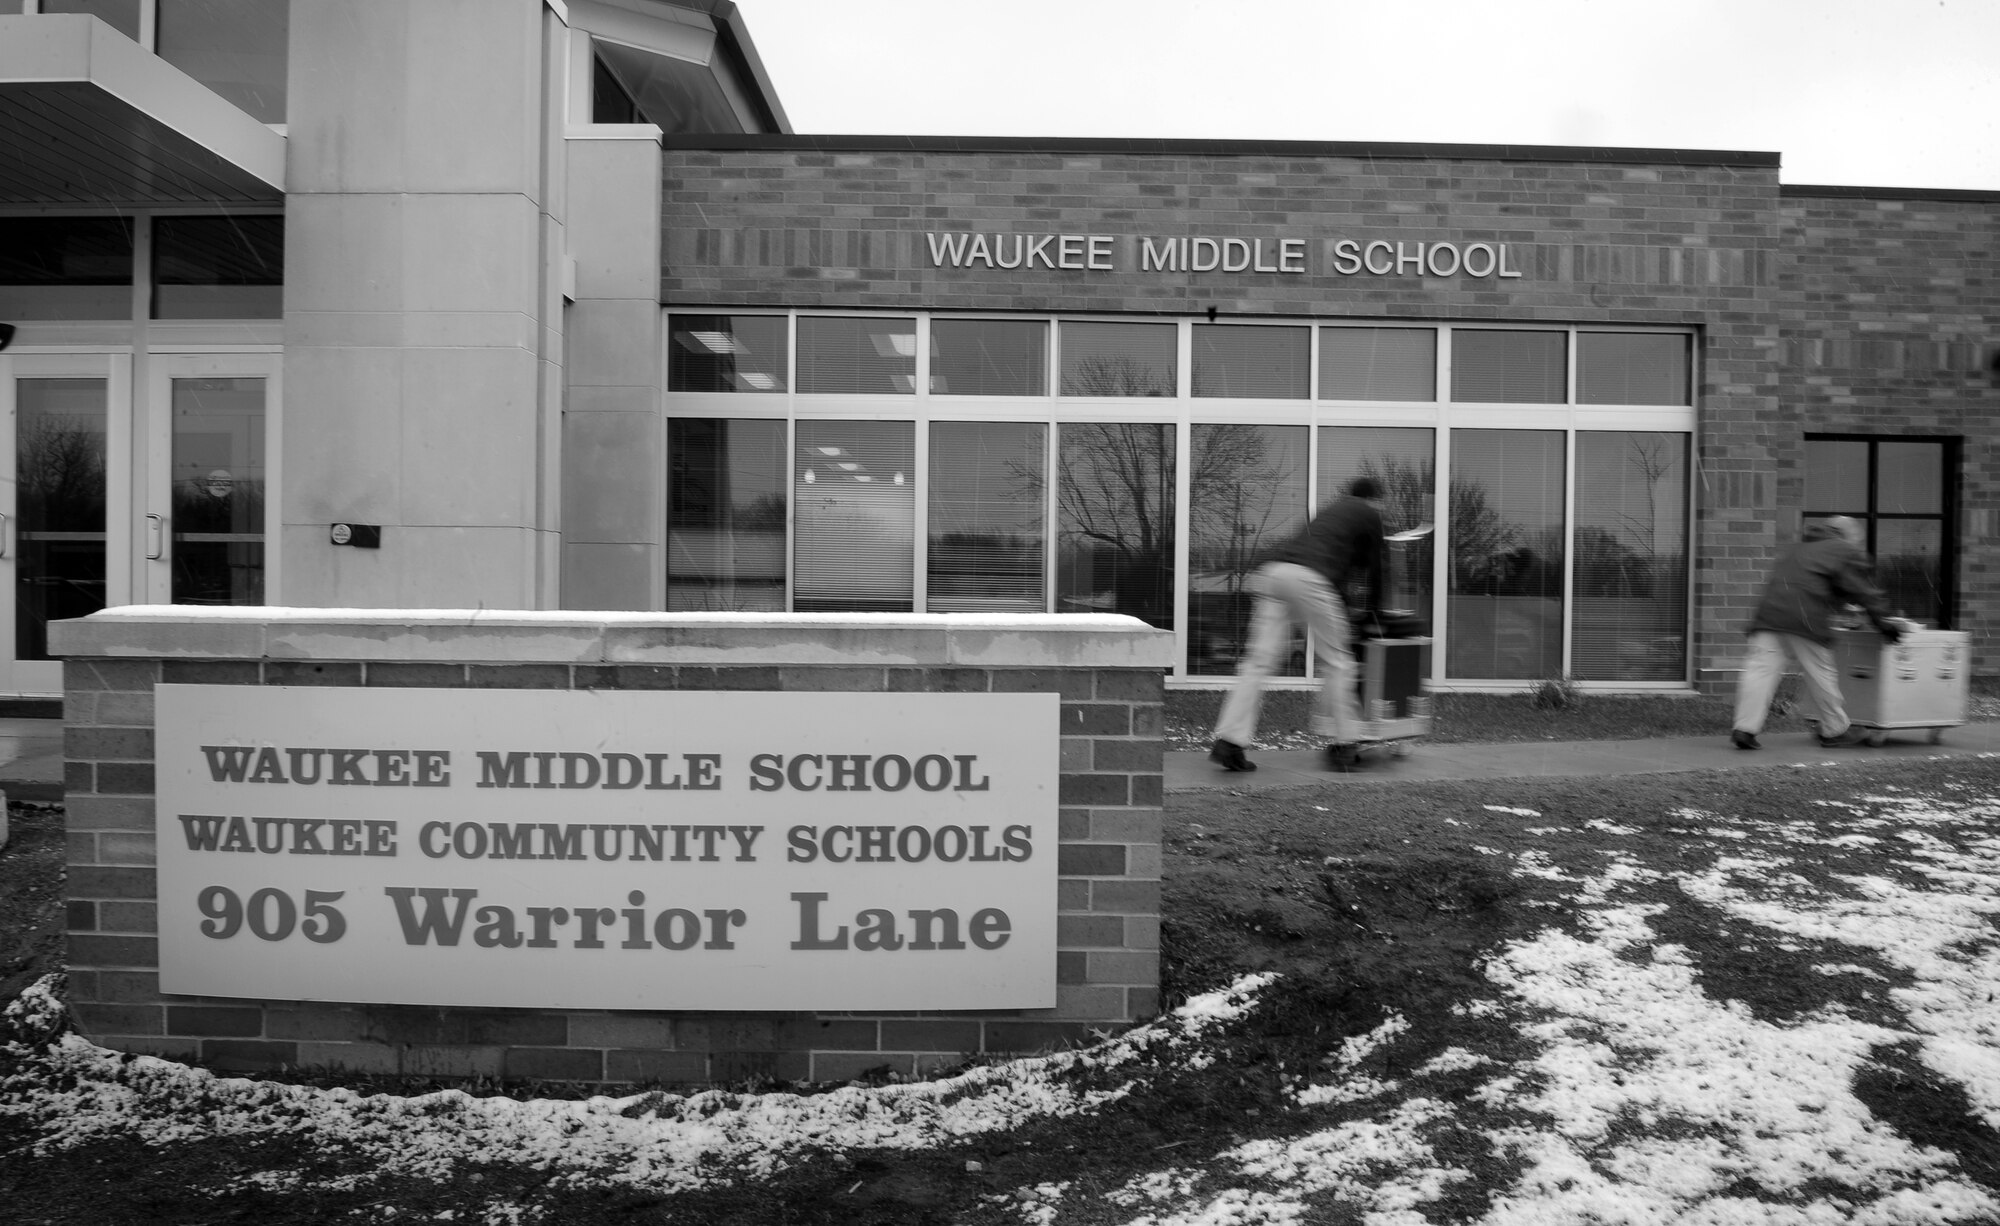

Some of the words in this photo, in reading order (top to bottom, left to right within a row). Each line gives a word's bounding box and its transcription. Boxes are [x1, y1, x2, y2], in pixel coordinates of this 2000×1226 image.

[926, 232, 1115, 271] WAUKEE
[1142, 236, 1307, 274] MIDDLE
[1333, 238, 1524, 278] SCHOOL
[200, 745, 450, 787] WAUKEE
[476, 751, 721, 791] MIDDLE
[750, 753, 989, 792] SCHOOL
[178, 814, 397, 857] WAUKEE
[419, 820, 764, 863] COMMUNITY
[787, 825, 1033, 863] SCHOOLS
[197, 885, 347, 944] 905
[384, 886, 747, 951] Warrior
[790, 892, 1012, 952] Lane
